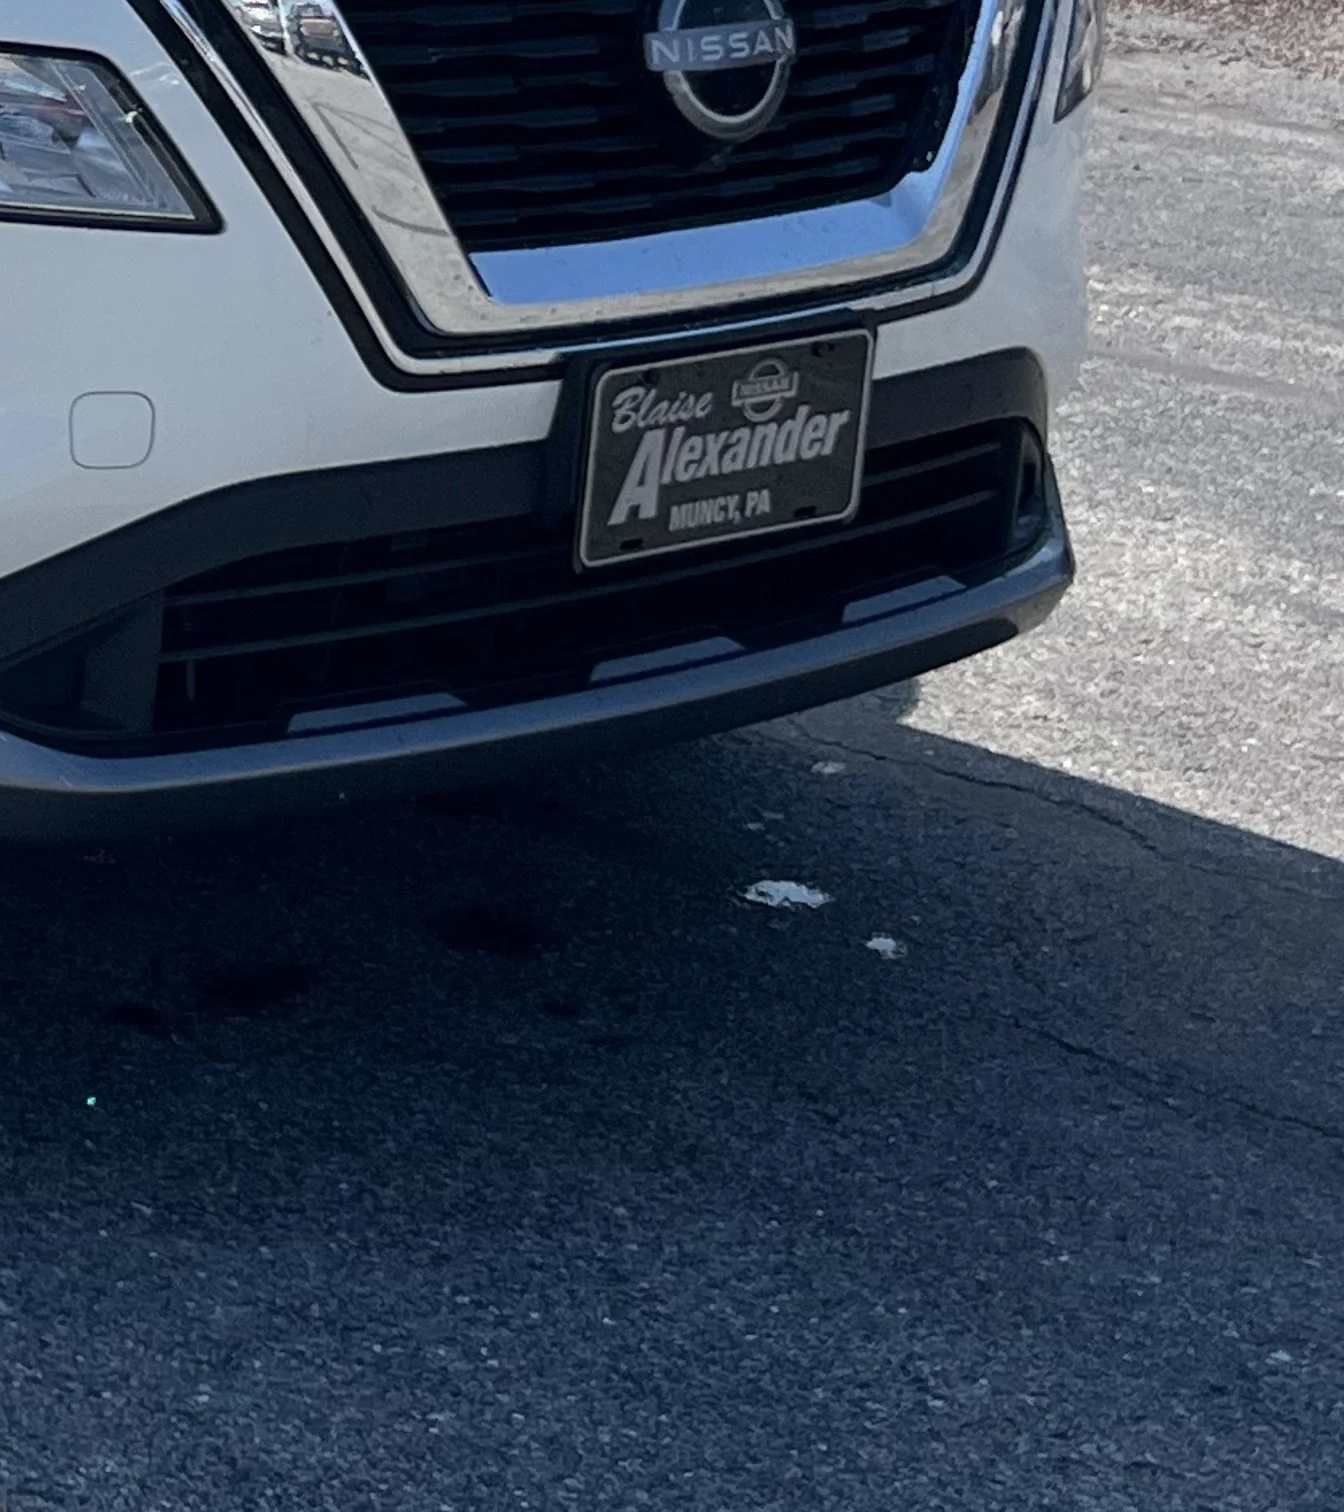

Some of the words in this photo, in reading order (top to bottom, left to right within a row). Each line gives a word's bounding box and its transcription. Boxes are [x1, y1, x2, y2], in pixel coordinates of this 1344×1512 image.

[650, 24, 796, 66] NISSAN
[611, 386, 714, 433] Blaise
[607, 404, 851, 526] Alexander
[668, 494, 743, 532] MUNCY,
[744, 489, 772, 517] PA
